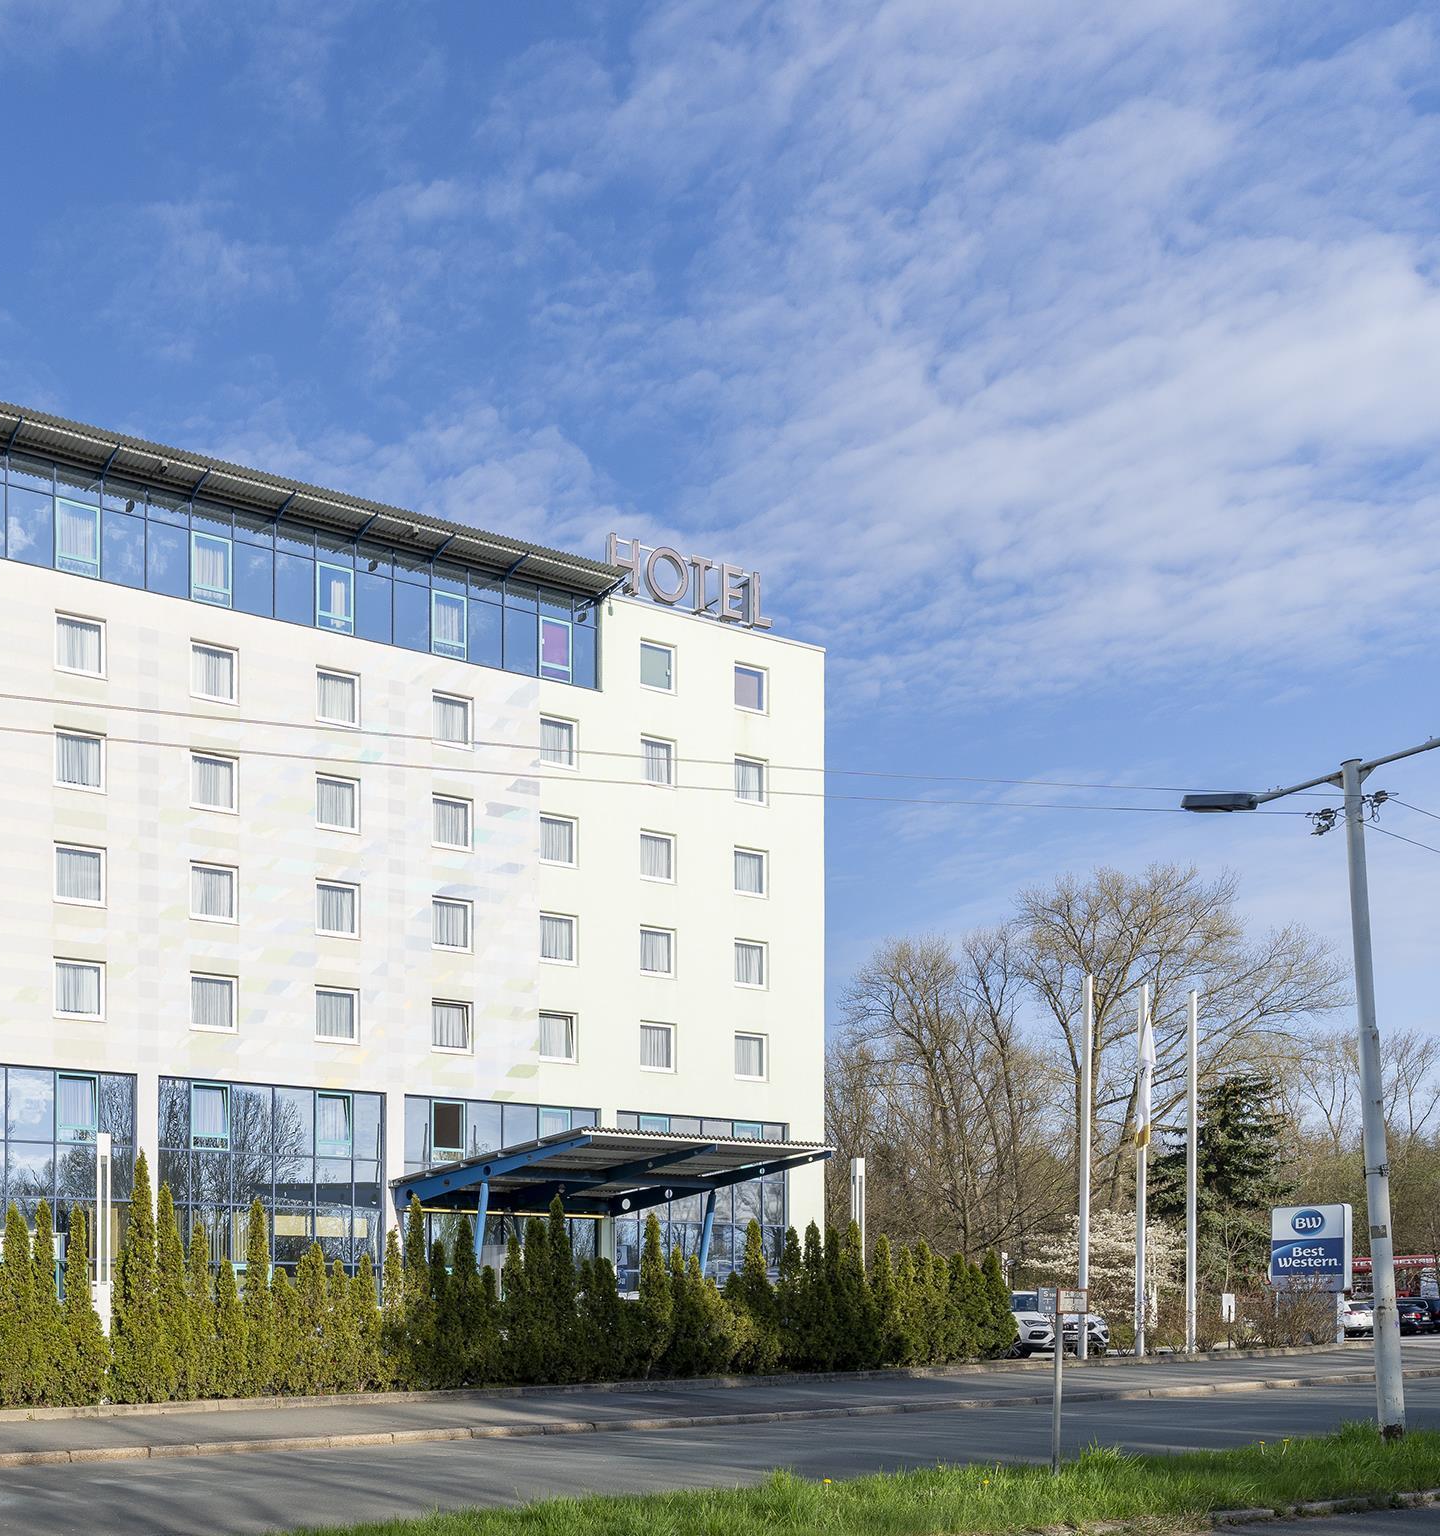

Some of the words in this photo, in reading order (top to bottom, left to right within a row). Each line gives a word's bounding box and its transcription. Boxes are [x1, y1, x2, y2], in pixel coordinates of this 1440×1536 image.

[605, 532, 772, 629] HOTEL
[1295, 1216, 1322, 1230] BW
[1292, 1246, 1325, 1257] Best
